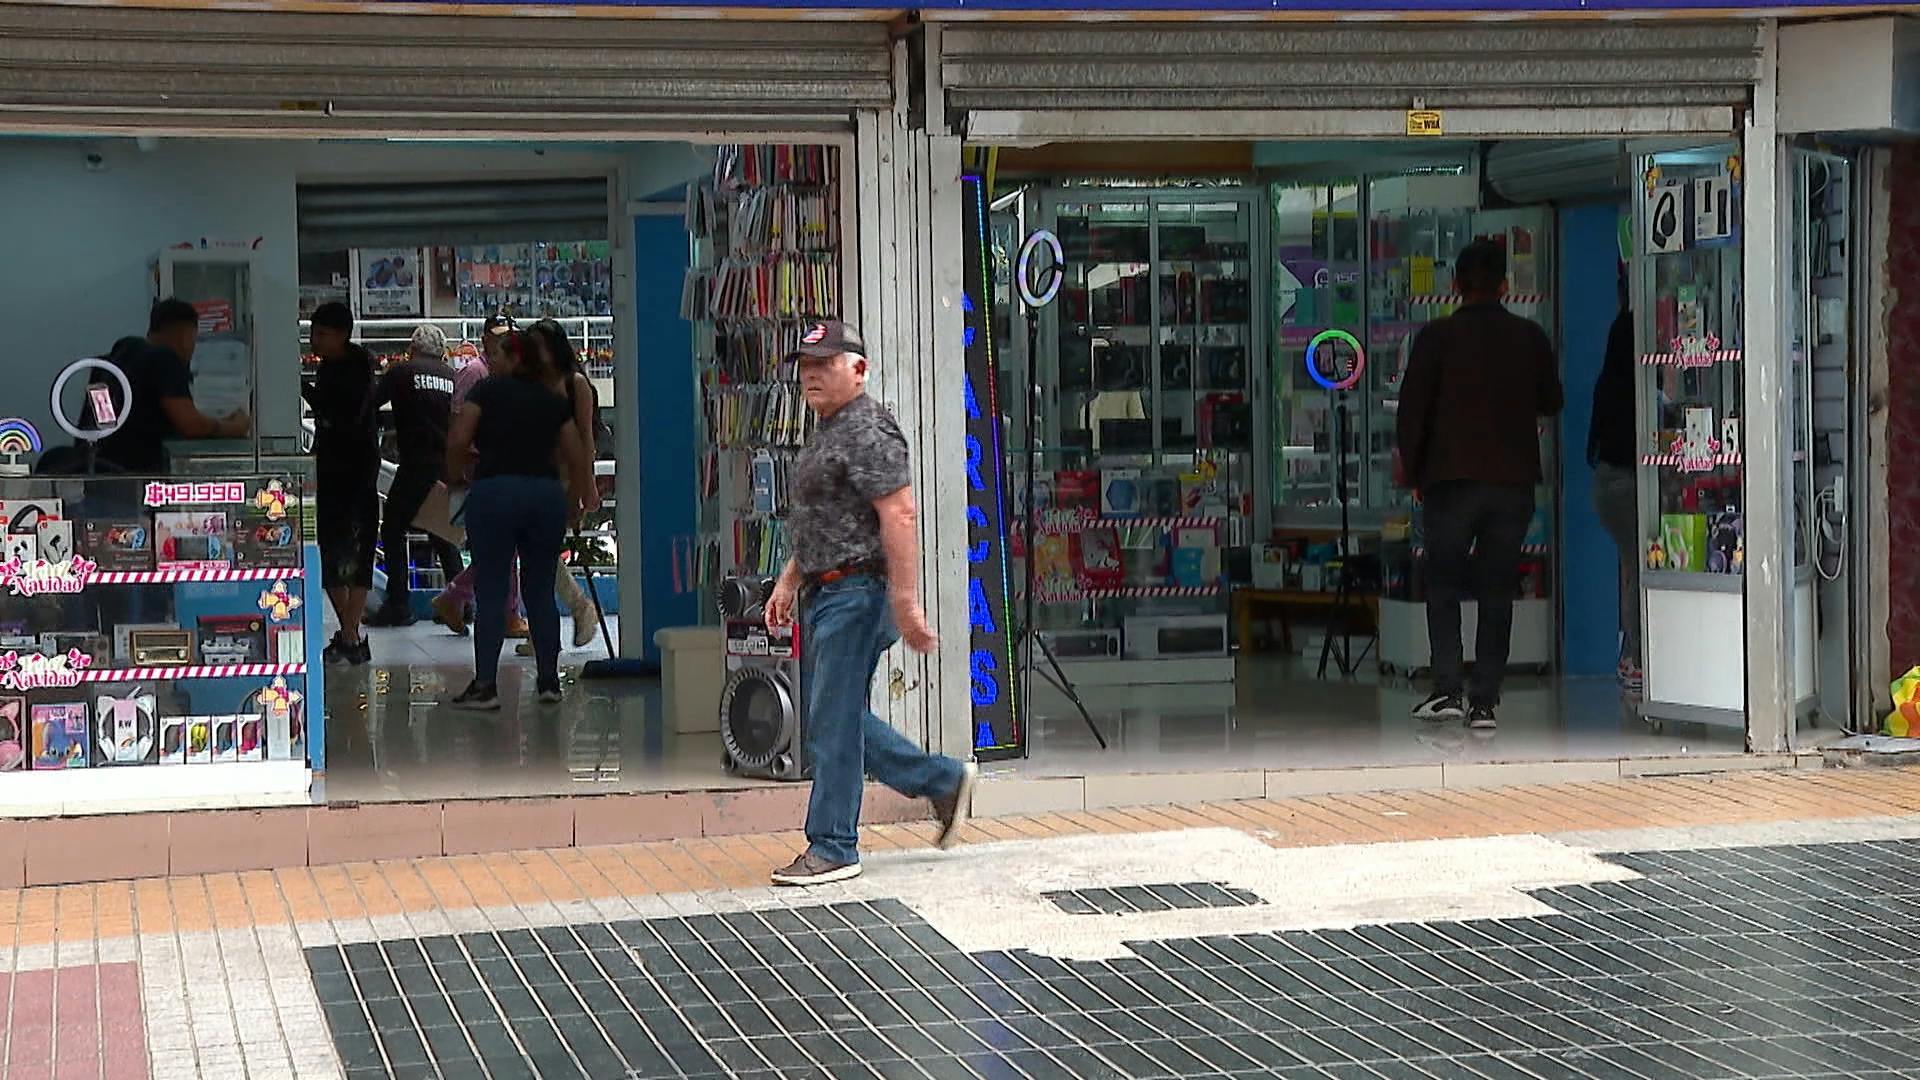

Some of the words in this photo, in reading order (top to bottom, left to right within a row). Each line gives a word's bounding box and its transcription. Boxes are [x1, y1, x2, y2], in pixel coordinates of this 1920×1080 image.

[414, 374, 454, 393] SEGURID
[11, 574, 84, 597] Navidad
[7, 669, 80, 691] Navidad
